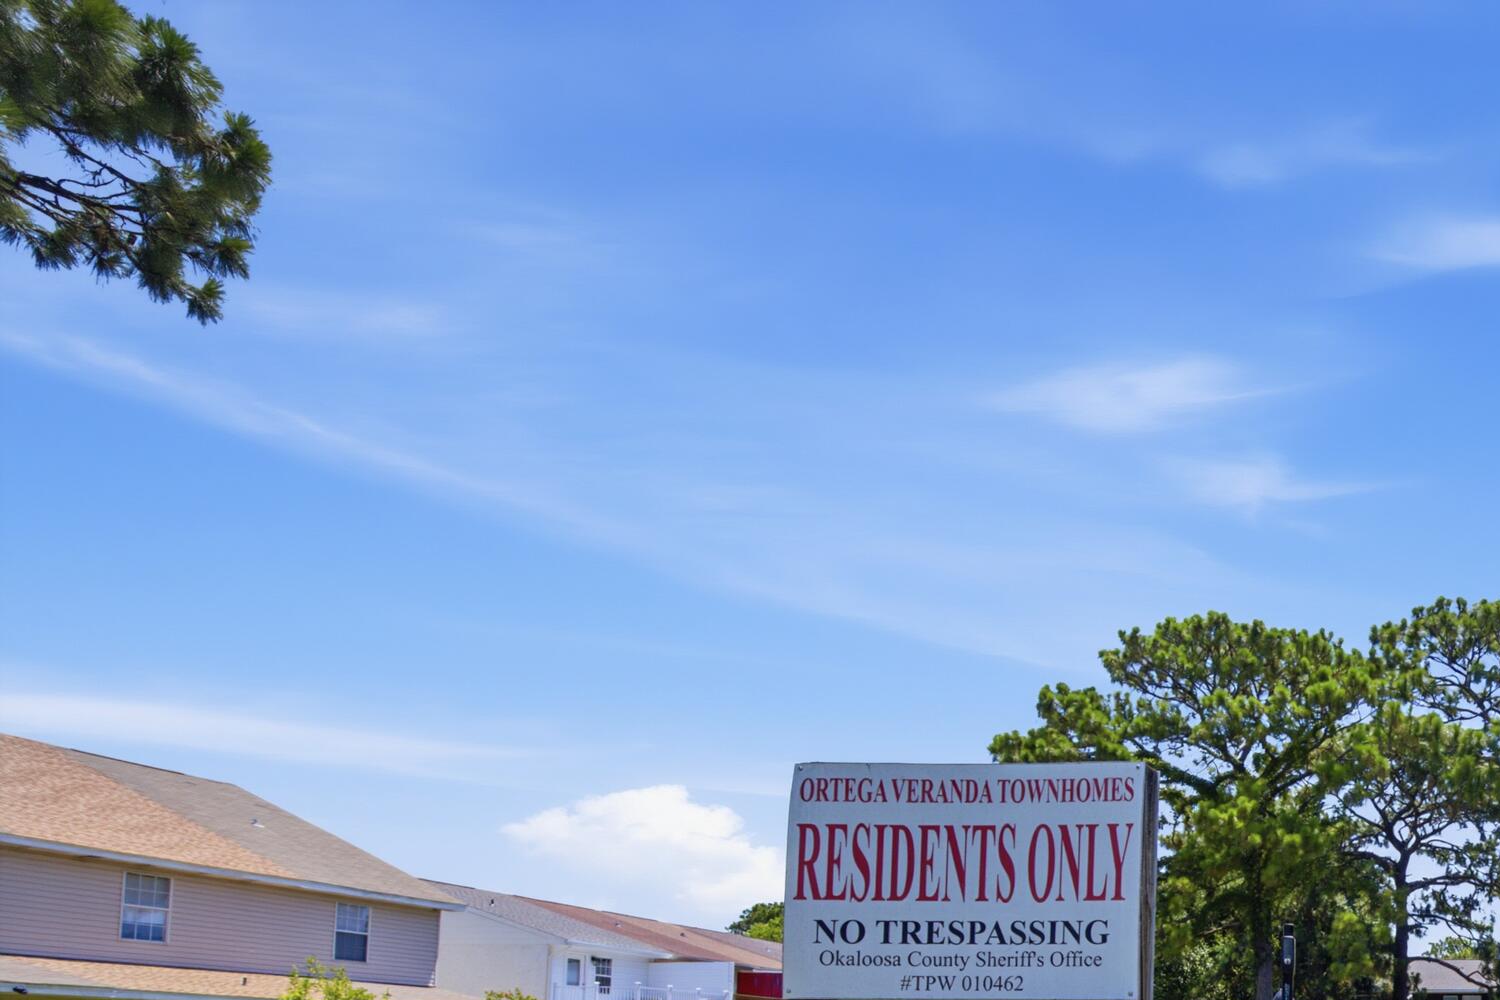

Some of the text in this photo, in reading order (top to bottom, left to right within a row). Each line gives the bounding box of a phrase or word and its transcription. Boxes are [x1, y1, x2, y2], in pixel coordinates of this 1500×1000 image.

[800, 777, 1135, 804] ORTEGA VERANDA TOWNHOMES
[793, 822, 1134, 903] RESIDENTS ONLY
[813, 918, 1110, 946] NO TRESPASSING
[819, 950, 1103, 972] Okaloosa County Sheriff's Office
[899, 974, 1024, 992] #TPW 010462
